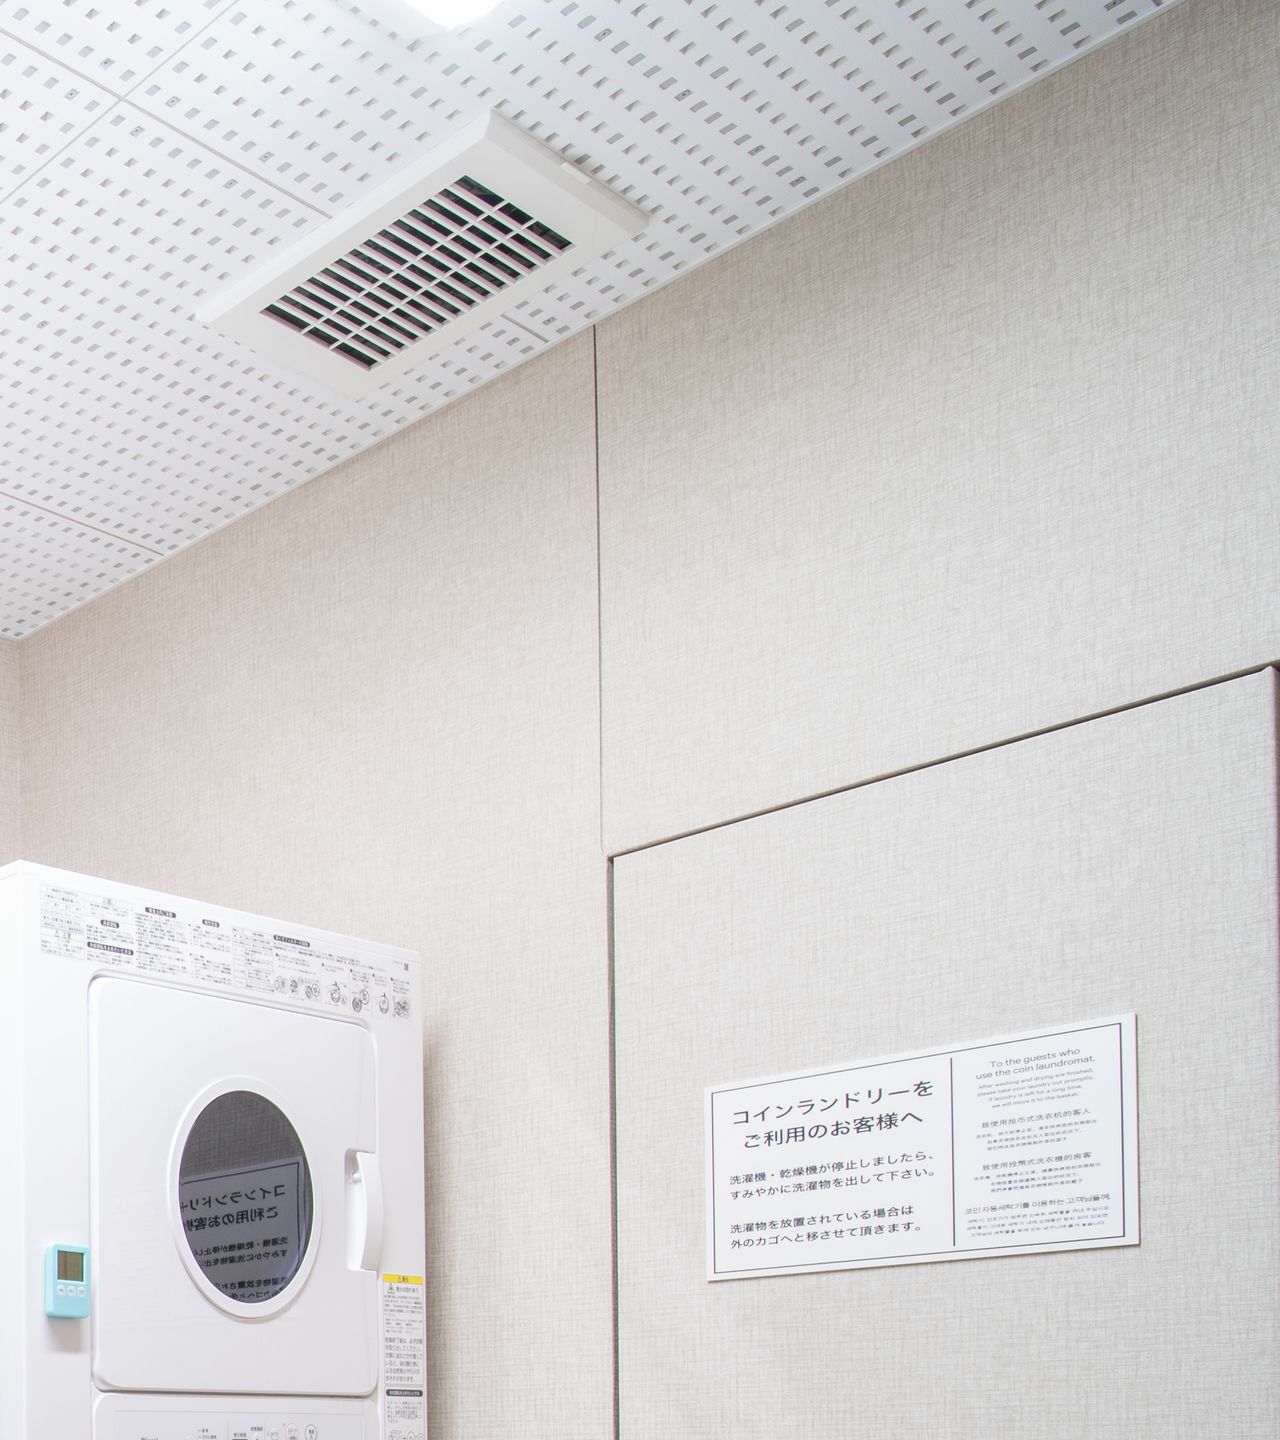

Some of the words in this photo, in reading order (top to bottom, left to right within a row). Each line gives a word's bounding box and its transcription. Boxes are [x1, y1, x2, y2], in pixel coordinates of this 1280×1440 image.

[995, 1068, 1011, 1077] the
[1013, 1065, 1033, 1074] coin
[1036, 1056, 1095, 1070] laundromat.
[1024, 1053, 1056, 1064] guests
[1059, 1048, 1080, 1057] who
[733, 1081, 933, 1125] コインランドリーを
[744, 1112, 922, 1148] ご利用のお客様へ
[730, 1152, 933, 1185] 洗濯機・乾燥機が停止しましたら、
[731, 1167, 934, 1200] すみやかに洗濯物を出して下さい。
[731, 1205, 914, 1233] 洗濯物を放置されている場合は
[731, 1222, 920, 1249] 外のカゴへと移させて頂きます。
